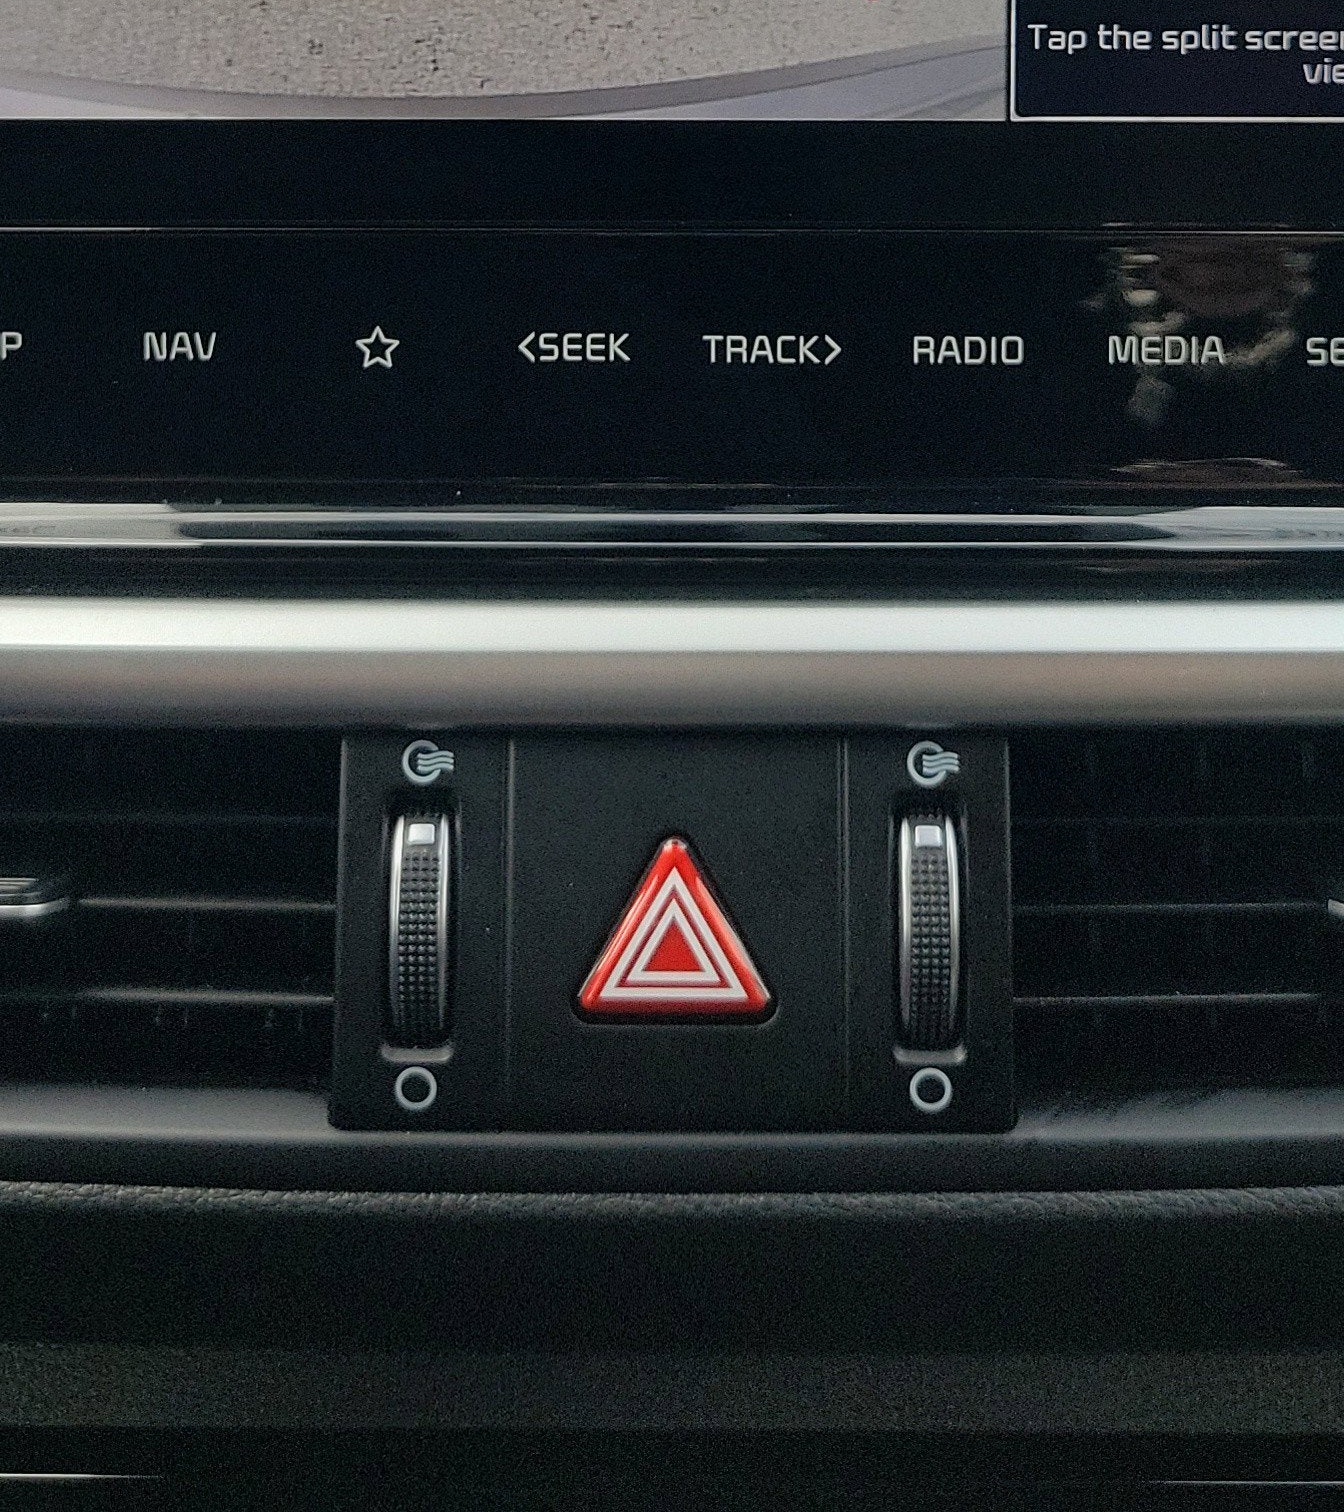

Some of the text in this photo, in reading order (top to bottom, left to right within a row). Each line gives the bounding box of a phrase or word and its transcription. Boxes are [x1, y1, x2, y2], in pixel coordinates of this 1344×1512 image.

[1027, 24, 1088, 55] Tap
[1097, 24, 1152, 50] the
[1161, 24, 1239, 55] split
[143, 331, 218, 361] NAV
[911, 336, 1025, 366] RADIO
[1108, 335, 1225, 366] MEDIA
